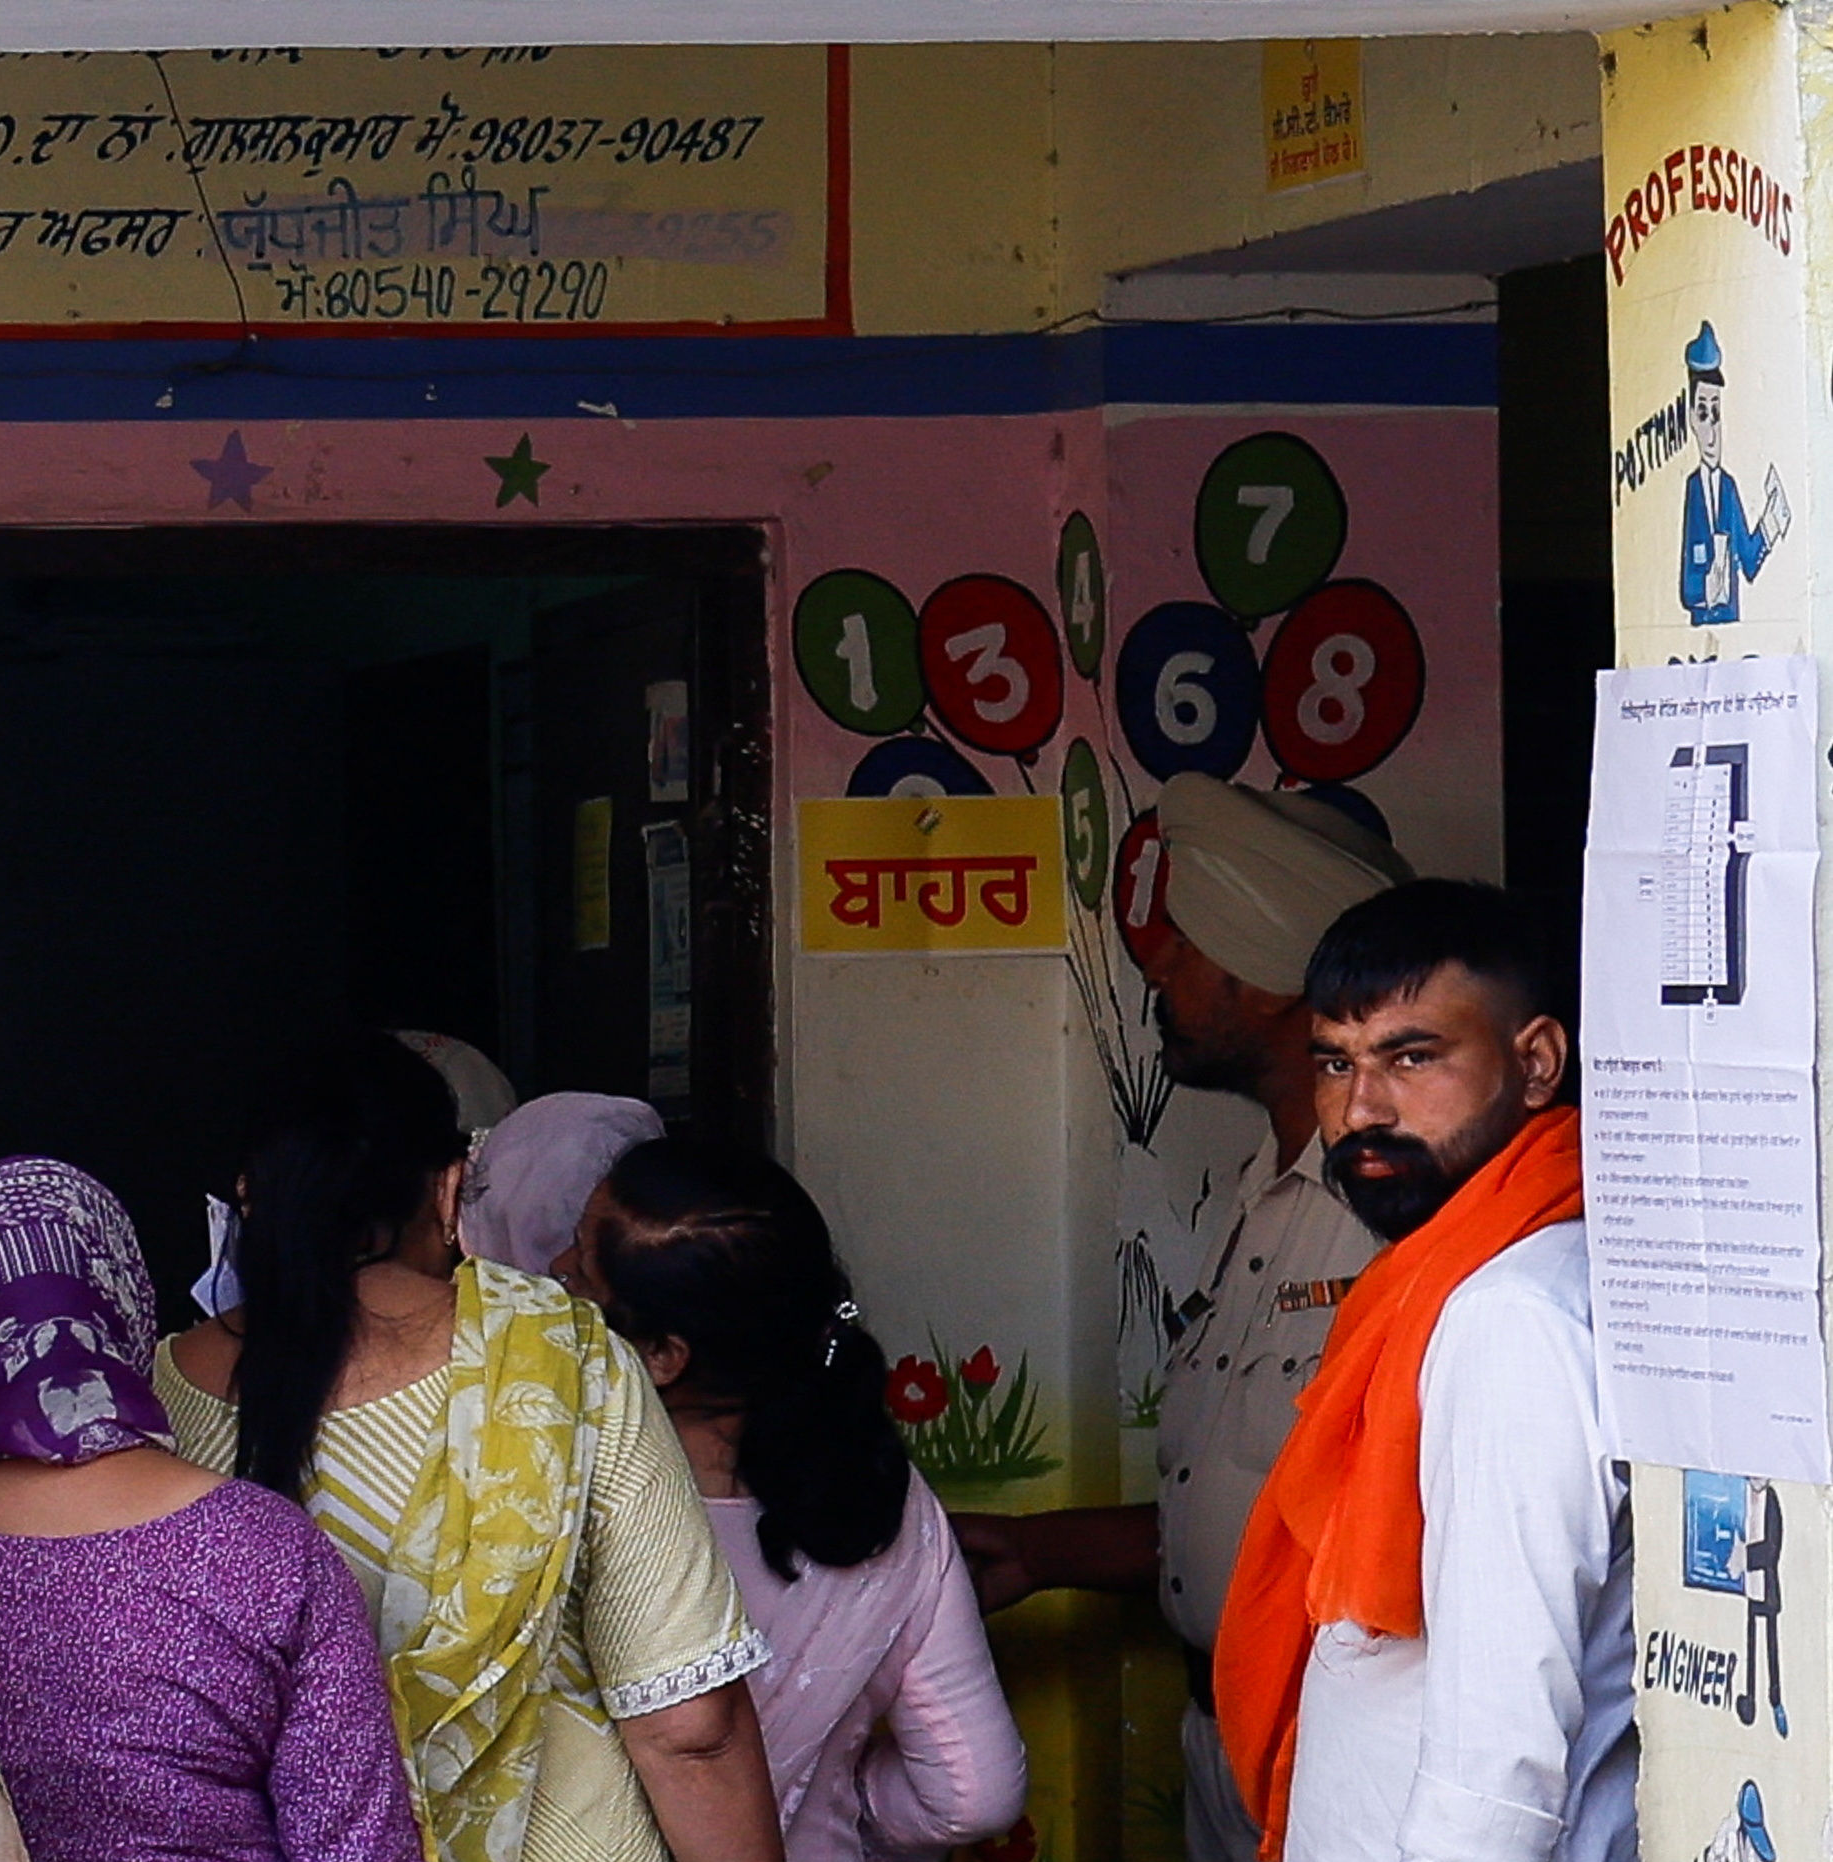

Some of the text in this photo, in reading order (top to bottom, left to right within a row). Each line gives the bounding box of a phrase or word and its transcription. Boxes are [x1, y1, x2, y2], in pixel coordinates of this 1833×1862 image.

[1605, 143, 1793, 287] PROFESSIONS
[1614, 387, 1689, 506] POSTMAN
[1235, 485, 1295, 565] 7
[1071, 549, 1094, 650] 4
[835, 612, 873, 713] 1
[945, 623, 1031, 723] 3
[1153, 650, 1218, 745] 6
[1296, 633, 1377, 745] 8
[1068, 783, 1095, 877] 5
[825, 856, 1037, 928] ਬਾਹਰ
[1642, 1628, 1739, 1713] ENGINEER
